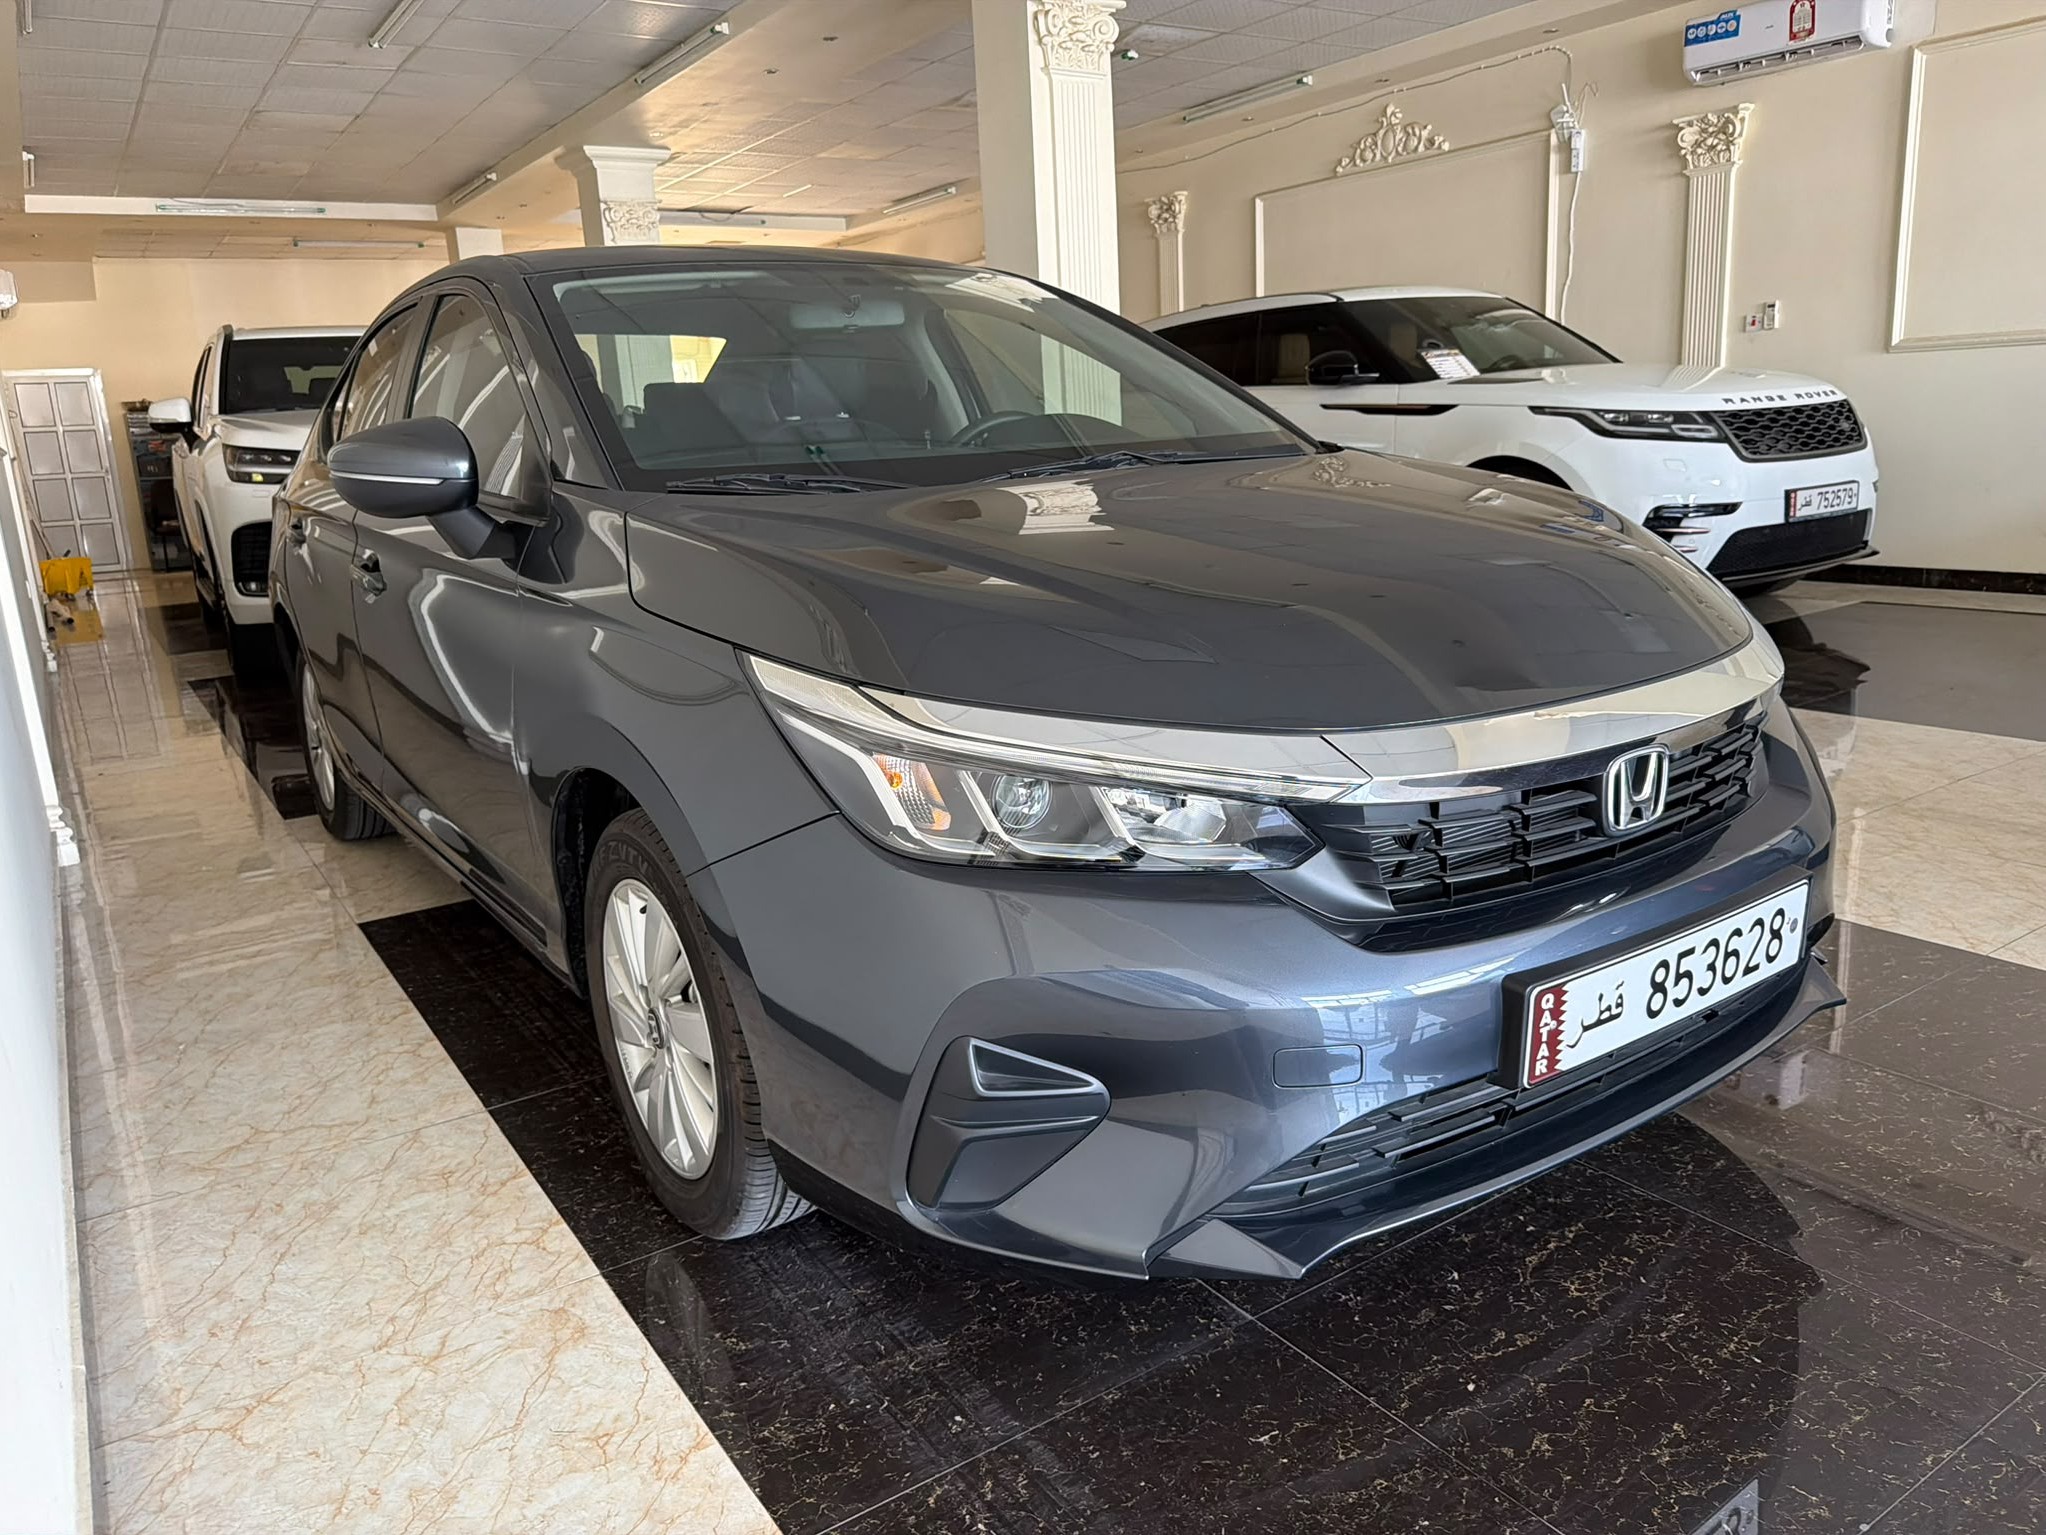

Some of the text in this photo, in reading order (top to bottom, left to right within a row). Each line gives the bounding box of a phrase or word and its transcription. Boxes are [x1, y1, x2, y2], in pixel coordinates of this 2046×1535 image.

[1721, 389, 1838, 405] RANGE ROVER
[1817, 487, 1854, 511] 752579
[1645, 907, 1786, 1020] 853628
[1535, 992, 1556, 1077] QATAR
[1566, 980, 1626, 1048] قطر
